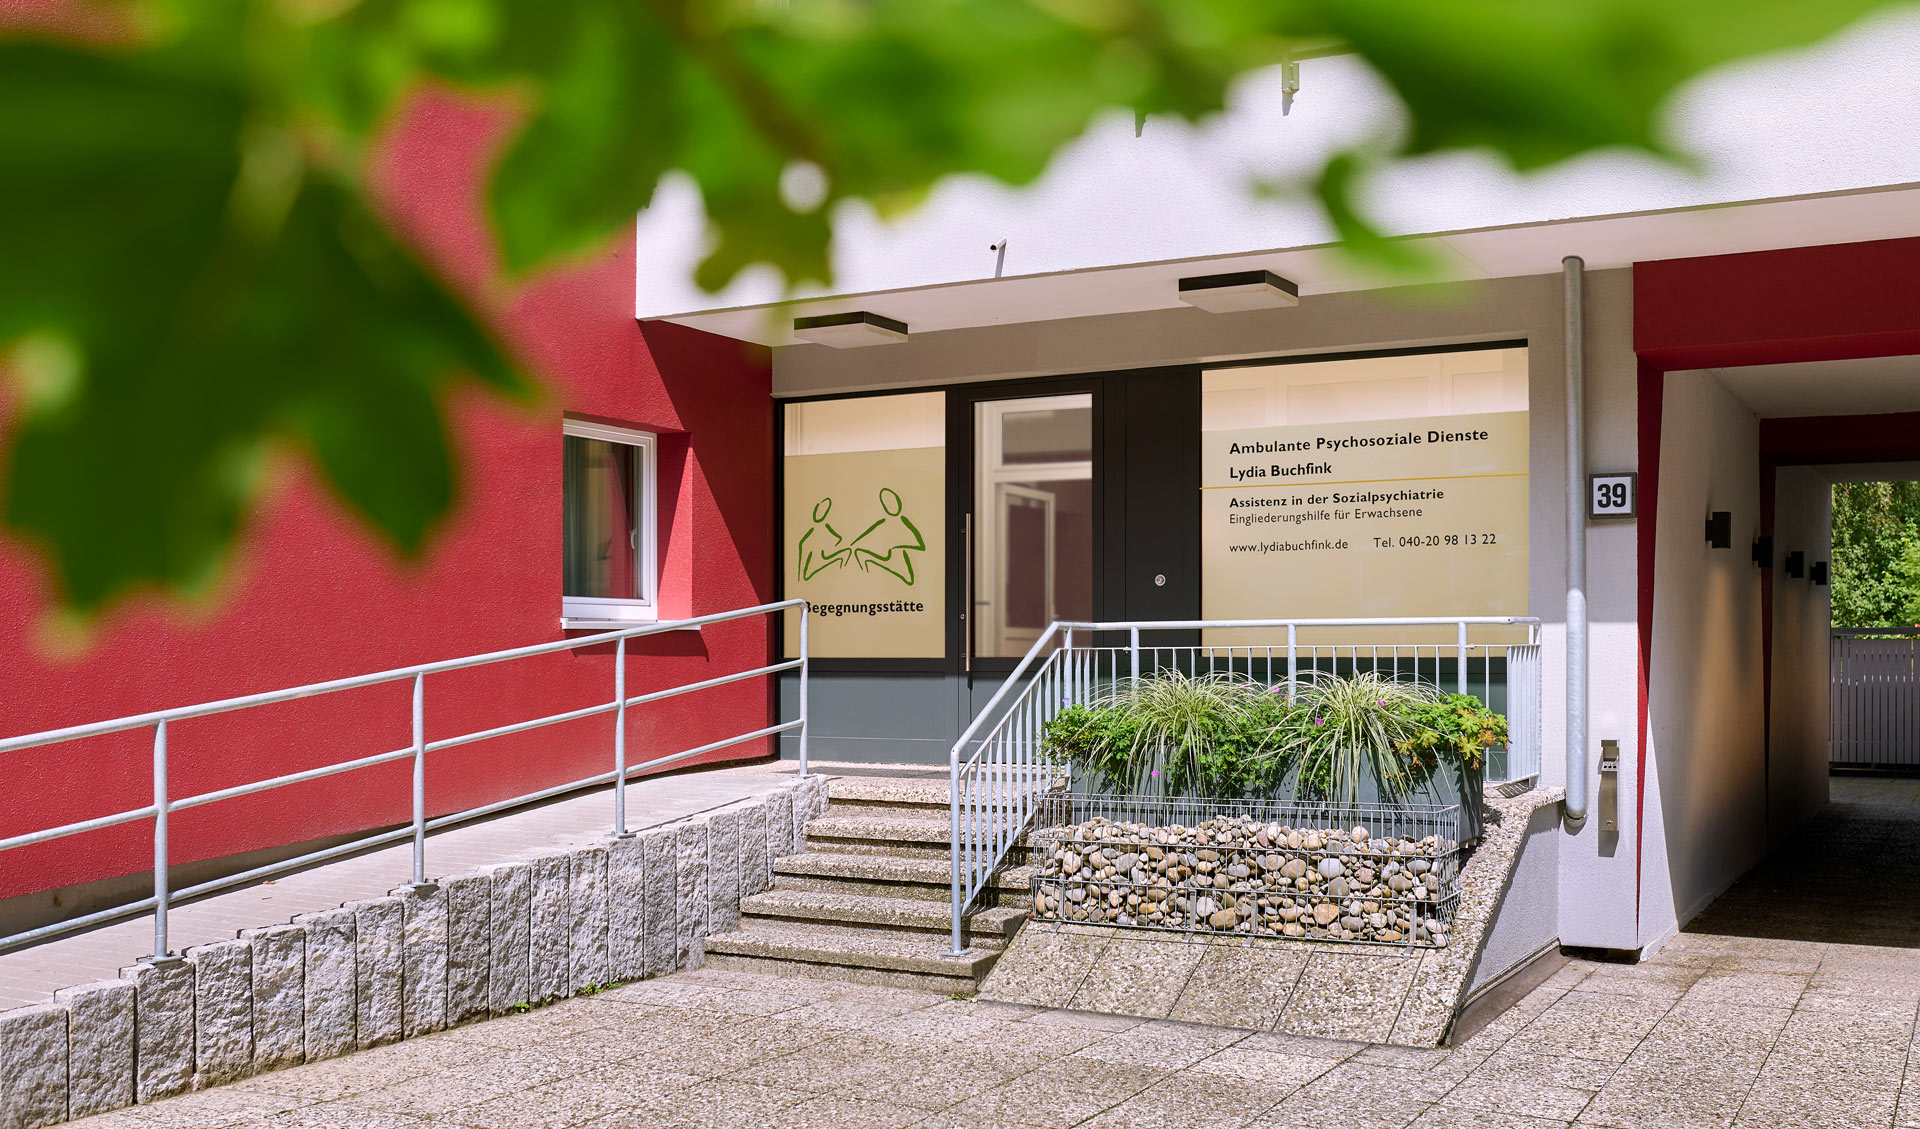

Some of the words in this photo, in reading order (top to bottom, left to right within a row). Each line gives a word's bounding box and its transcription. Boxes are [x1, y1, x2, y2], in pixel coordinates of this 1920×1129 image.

[1229, 440, 1311, 455] Ambulante
[1316, 431, 1422, 452] Psychosoziale
[1427, 429, 1489, 444] Dienste
[1229, 465, 1267, 482] Lydia
[1270, 461, 1332, 477] Buchfink
[1229, 496, 1288, 508] Assistenz
[1291, 495, 1303, 506] in
[1307, 494, 1329, 505] der
[1332, 488, 1444, 505] Sozialpsychiatrie
[1597, 482, 1627, 509] 39
[1229, 509, 1331, 527] Eingliederungshilfe
[1334, 509, 1351, 520] für
[1354, 507, 1423, 519] Erwachsene
[1229, 538, 1349, 555] www.lydiabuchfink.de
[1372, 536, 1395, 548] Tel.
[1398, 535, 1440, 548] 040-20
[1443, 534, 1459, 546] 98
[1464, 533, 1477, 545] 13
[1481, 533, 1497, 545] 22
